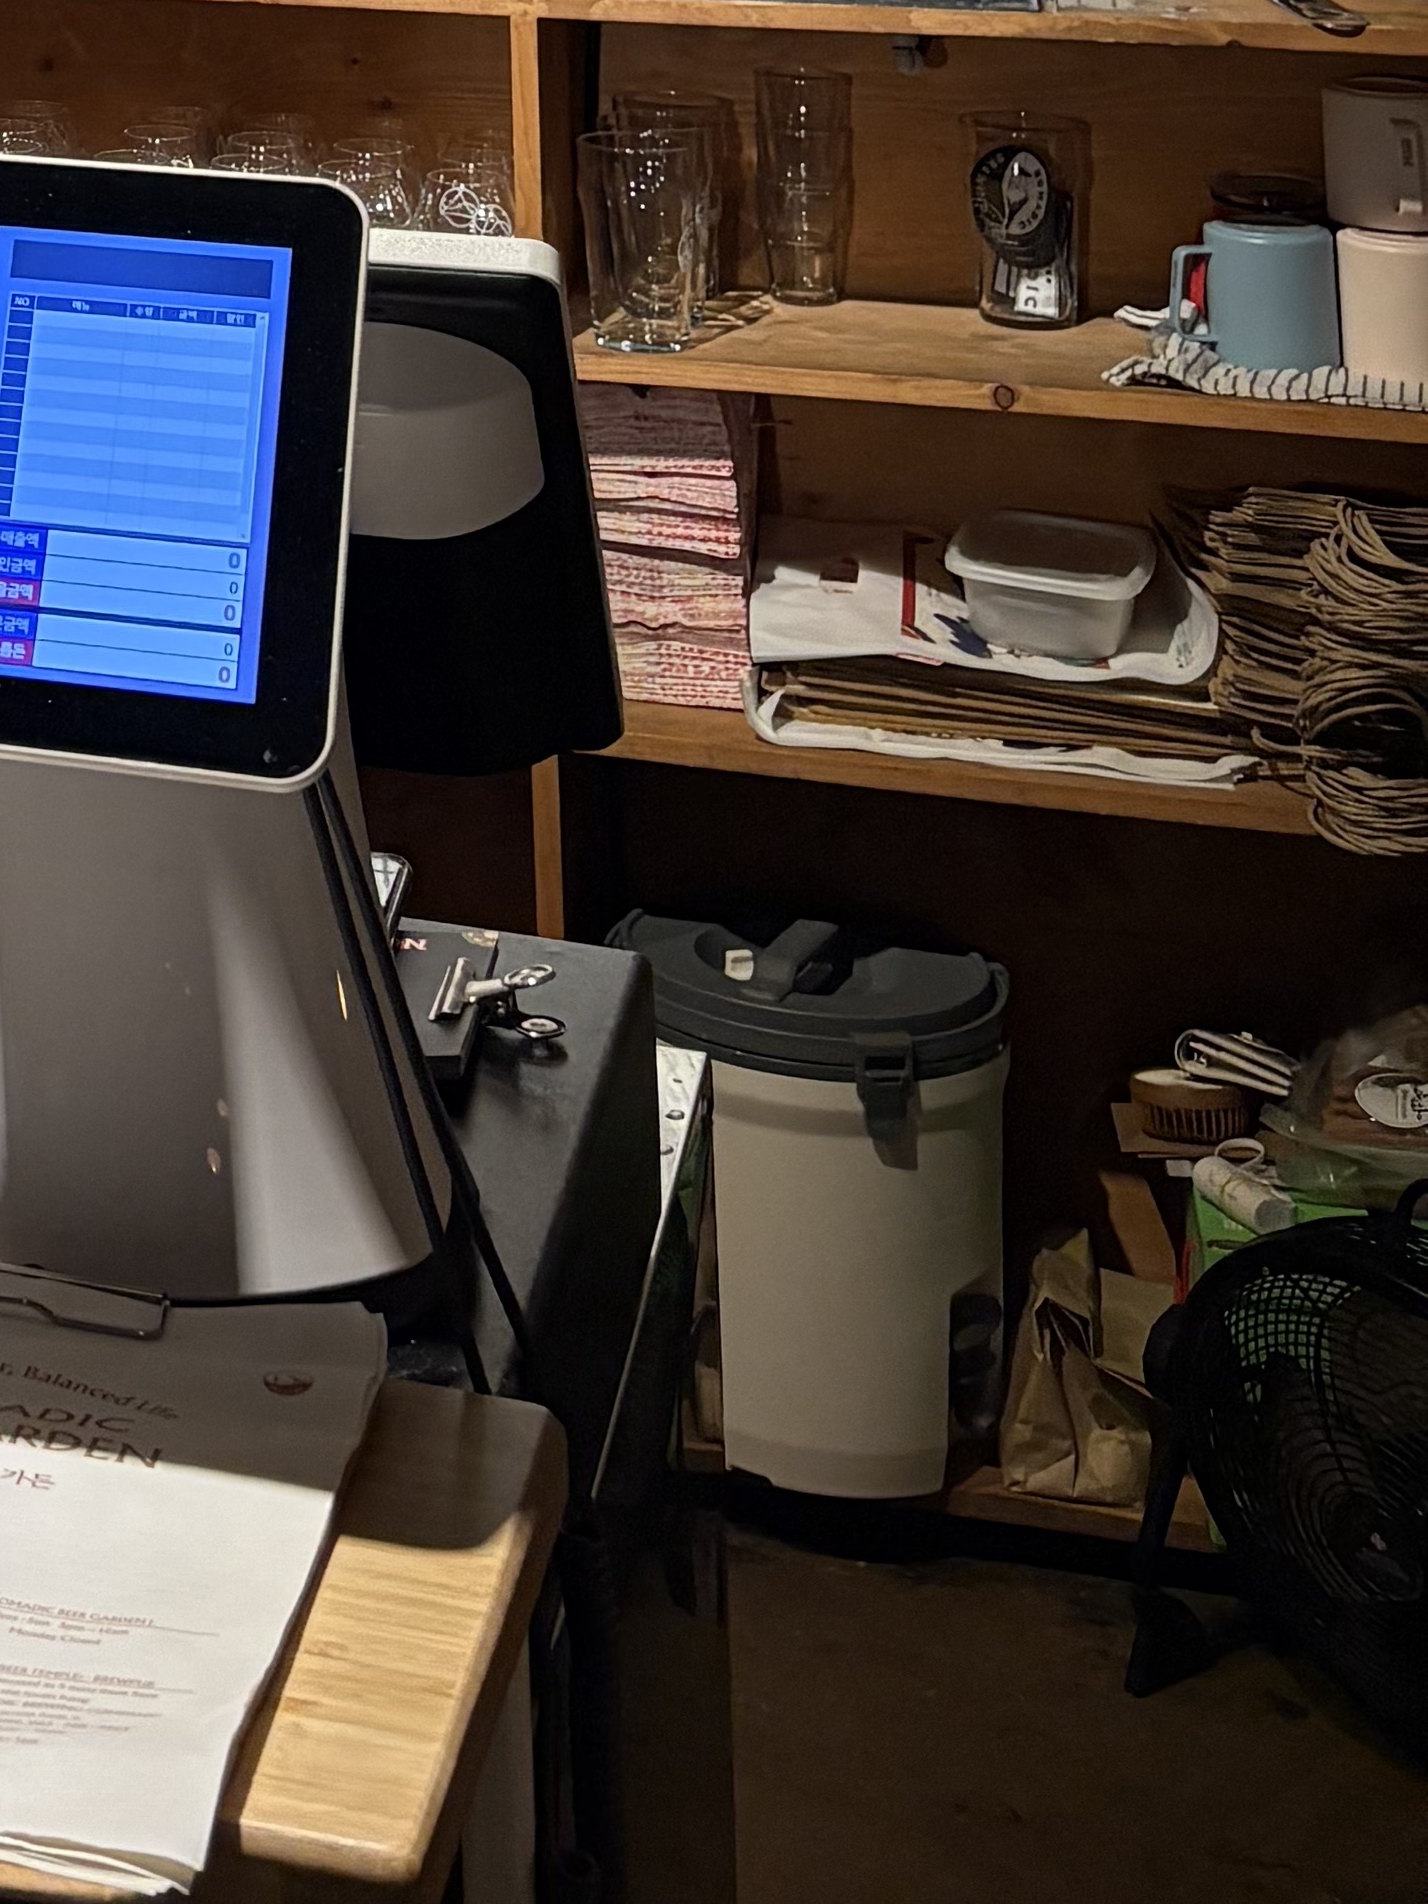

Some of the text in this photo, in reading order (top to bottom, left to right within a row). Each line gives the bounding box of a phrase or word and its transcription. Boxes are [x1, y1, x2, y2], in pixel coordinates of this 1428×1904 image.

[228, 552, 241, 569] 0
[229, 581, 239, 595] 0
[224, 604, 236, 622] 0
[224, 642, 233, 657] 0
[218, 665, 231, 684] 0
[0, 1466, 55, 1490] 가든
